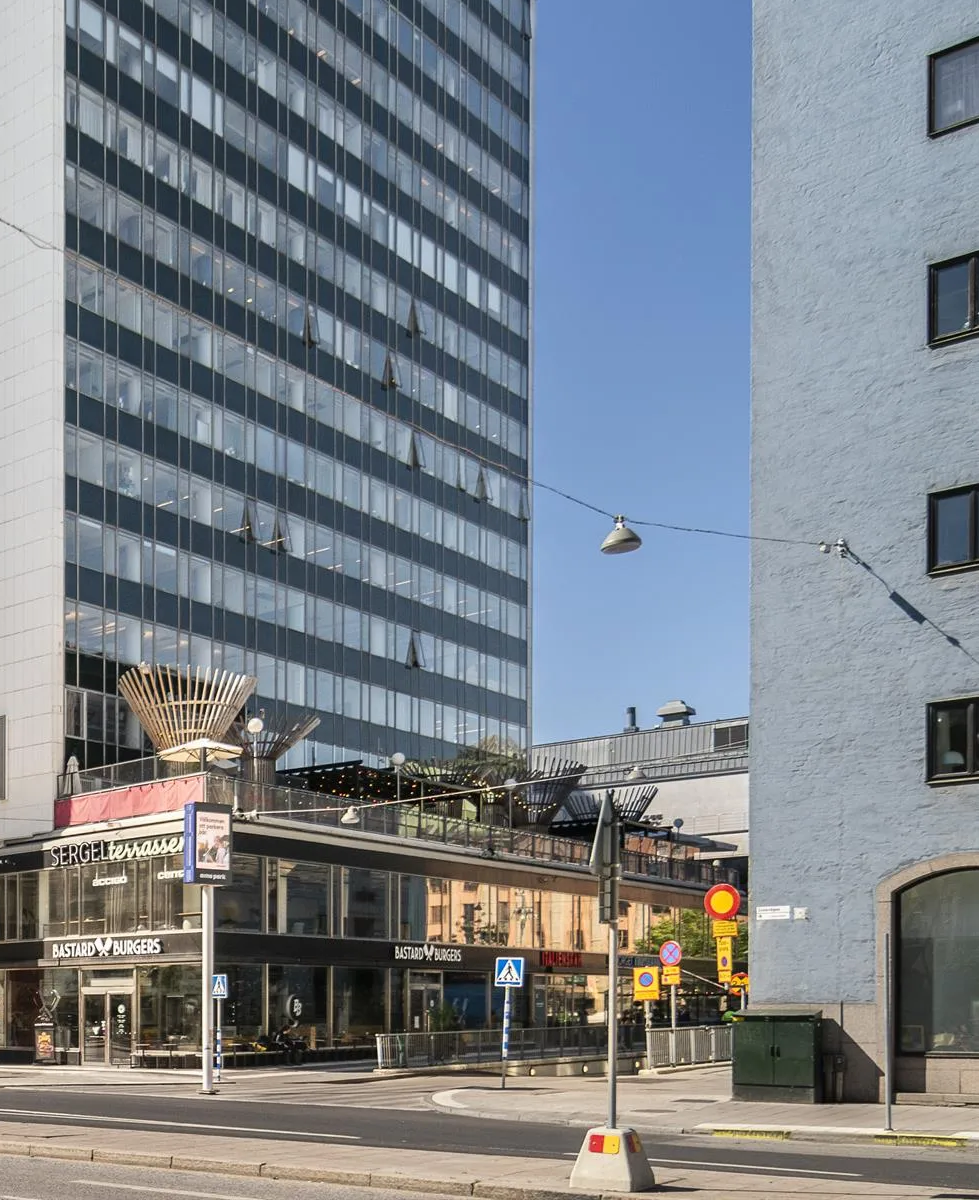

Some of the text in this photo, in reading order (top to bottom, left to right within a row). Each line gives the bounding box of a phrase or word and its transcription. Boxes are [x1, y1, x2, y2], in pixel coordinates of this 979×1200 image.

[52, 938, 162, 959] BASTARD BURGERS
[394, 945, 462, 962] BASTARD BURGERS
